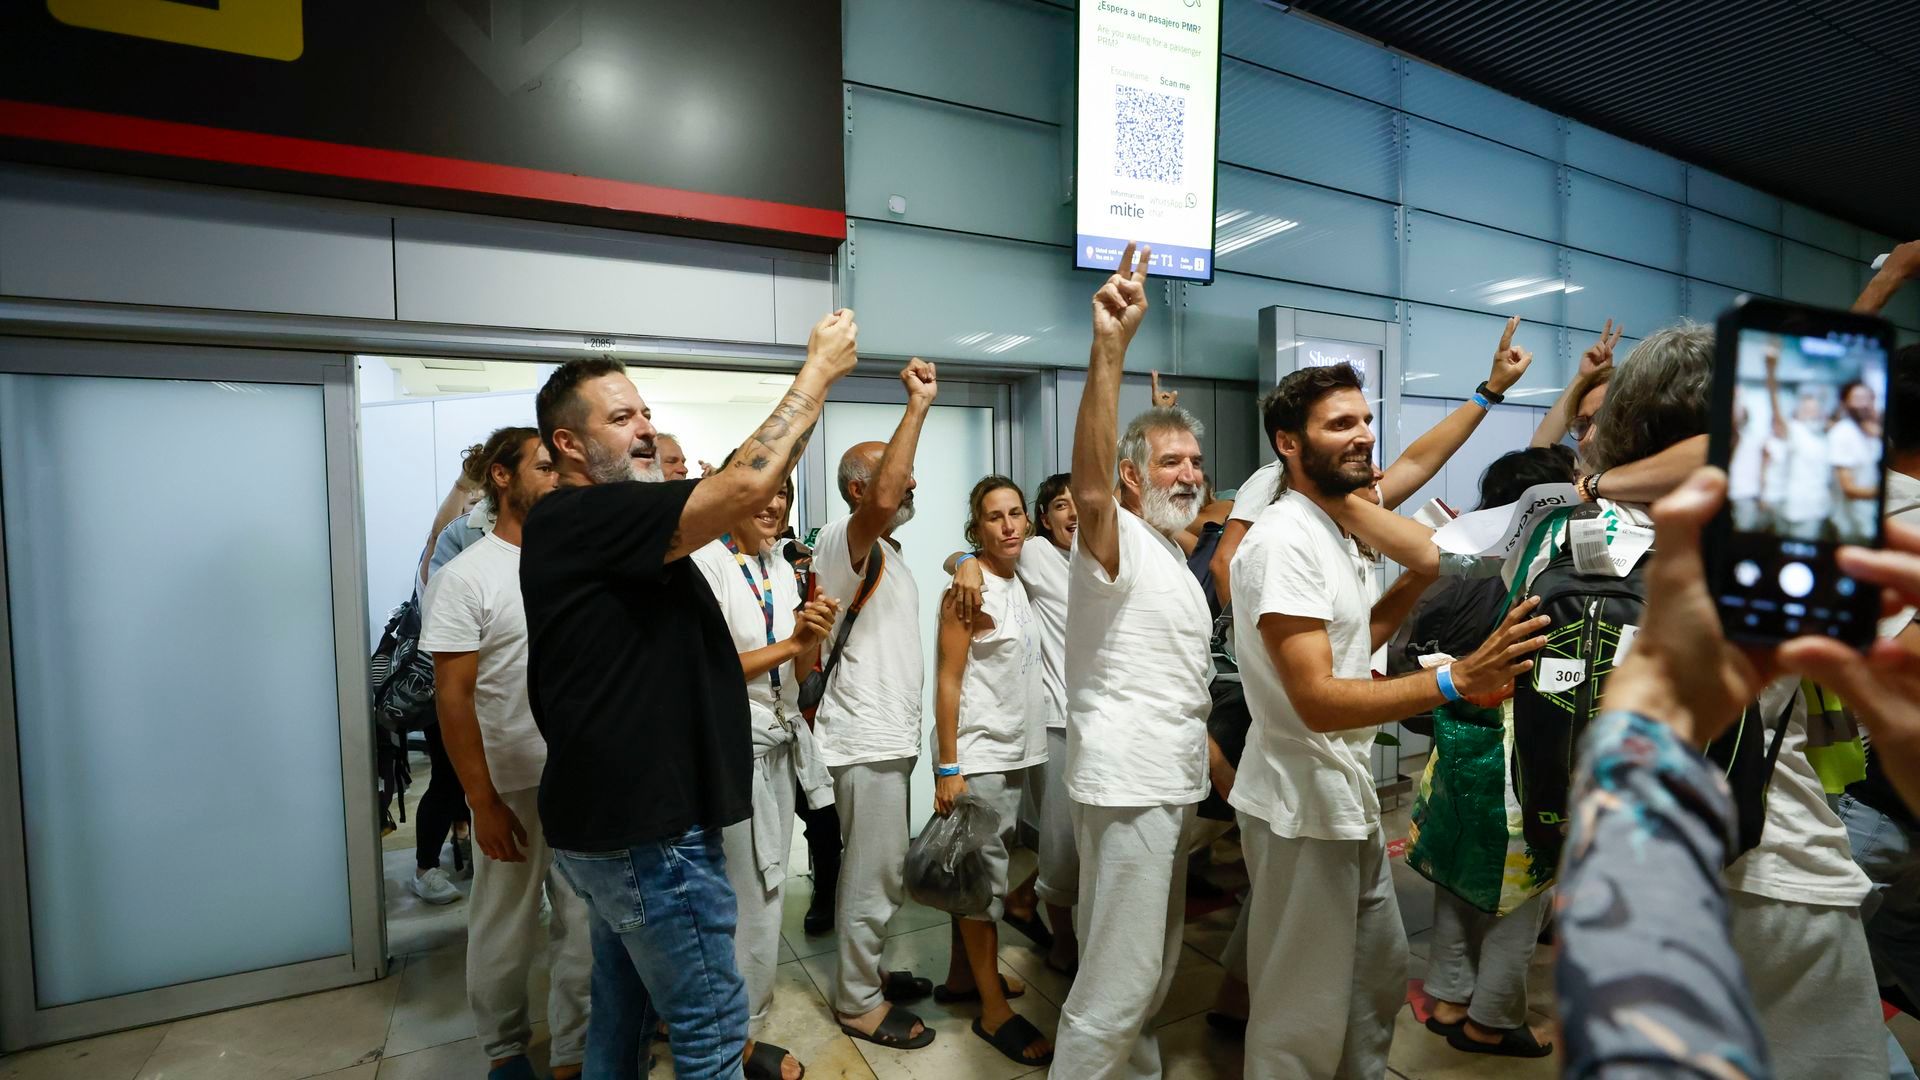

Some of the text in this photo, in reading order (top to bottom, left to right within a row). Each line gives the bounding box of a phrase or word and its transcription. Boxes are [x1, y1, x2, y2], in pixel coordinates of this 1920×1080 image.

[1098, 0, 1128, 15] ¿Espera
[1137, 12, 1147, 20] un
[1148, 14, 1180, 29] pasajero
[1181, 21, 1202, 34] PMR?
[1097, 24, 1110, 34] Are
[1111, 30, 1124, 38] you
[1126, 32, 1151, 46] waiting
[1152, 37, 1162, 47] for
[1169, 43, 1202, 57] passenger
[1097, 35, 1119, 47] PRM?
[1160, 76, 1191, 91] Scan me
[1110, 201, 1145, 219] mitie
[1161, 254, 1174, 267] T1
[590, 338, 611, 348] 2085
[1309, 350, 1366, 373] Shopng
[1555, 670, 1581, 683] 300
